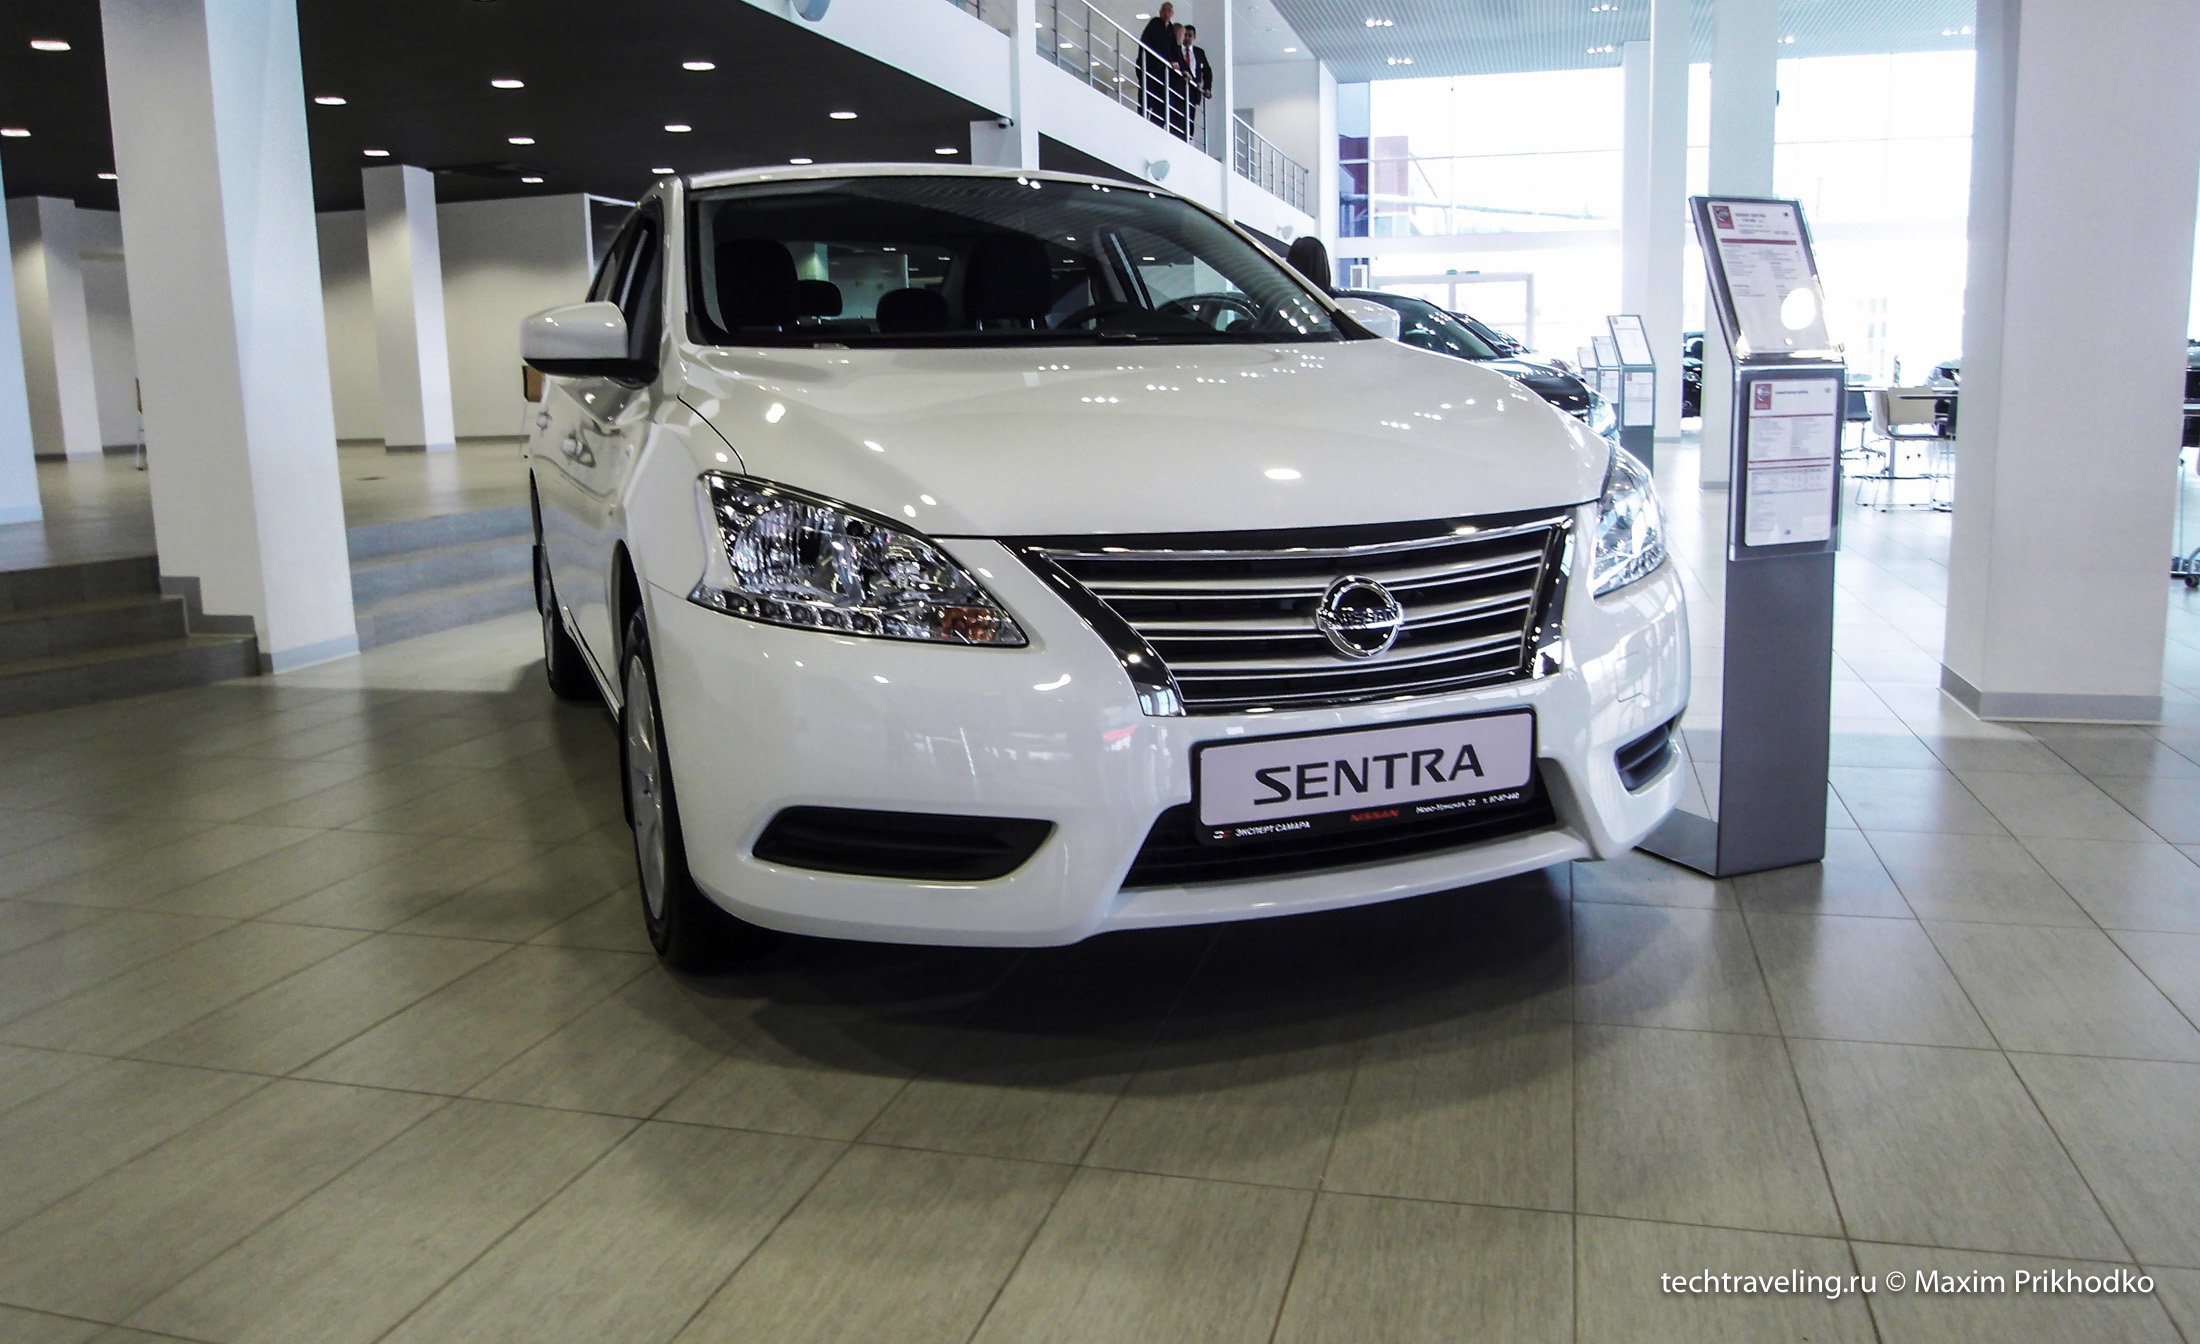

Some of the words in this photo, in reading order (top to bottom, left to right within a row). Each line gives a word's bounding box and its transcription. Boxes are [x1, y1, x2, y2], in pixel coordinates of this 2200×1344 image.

[1253, 743, 1485, 806] SENTRA
[1351, 809, 1399, 821] NISSAN
[1235, 825, 1274, 837] ЭКСПЕРТ
[1274, 820, 1311, 832] САМАРА
